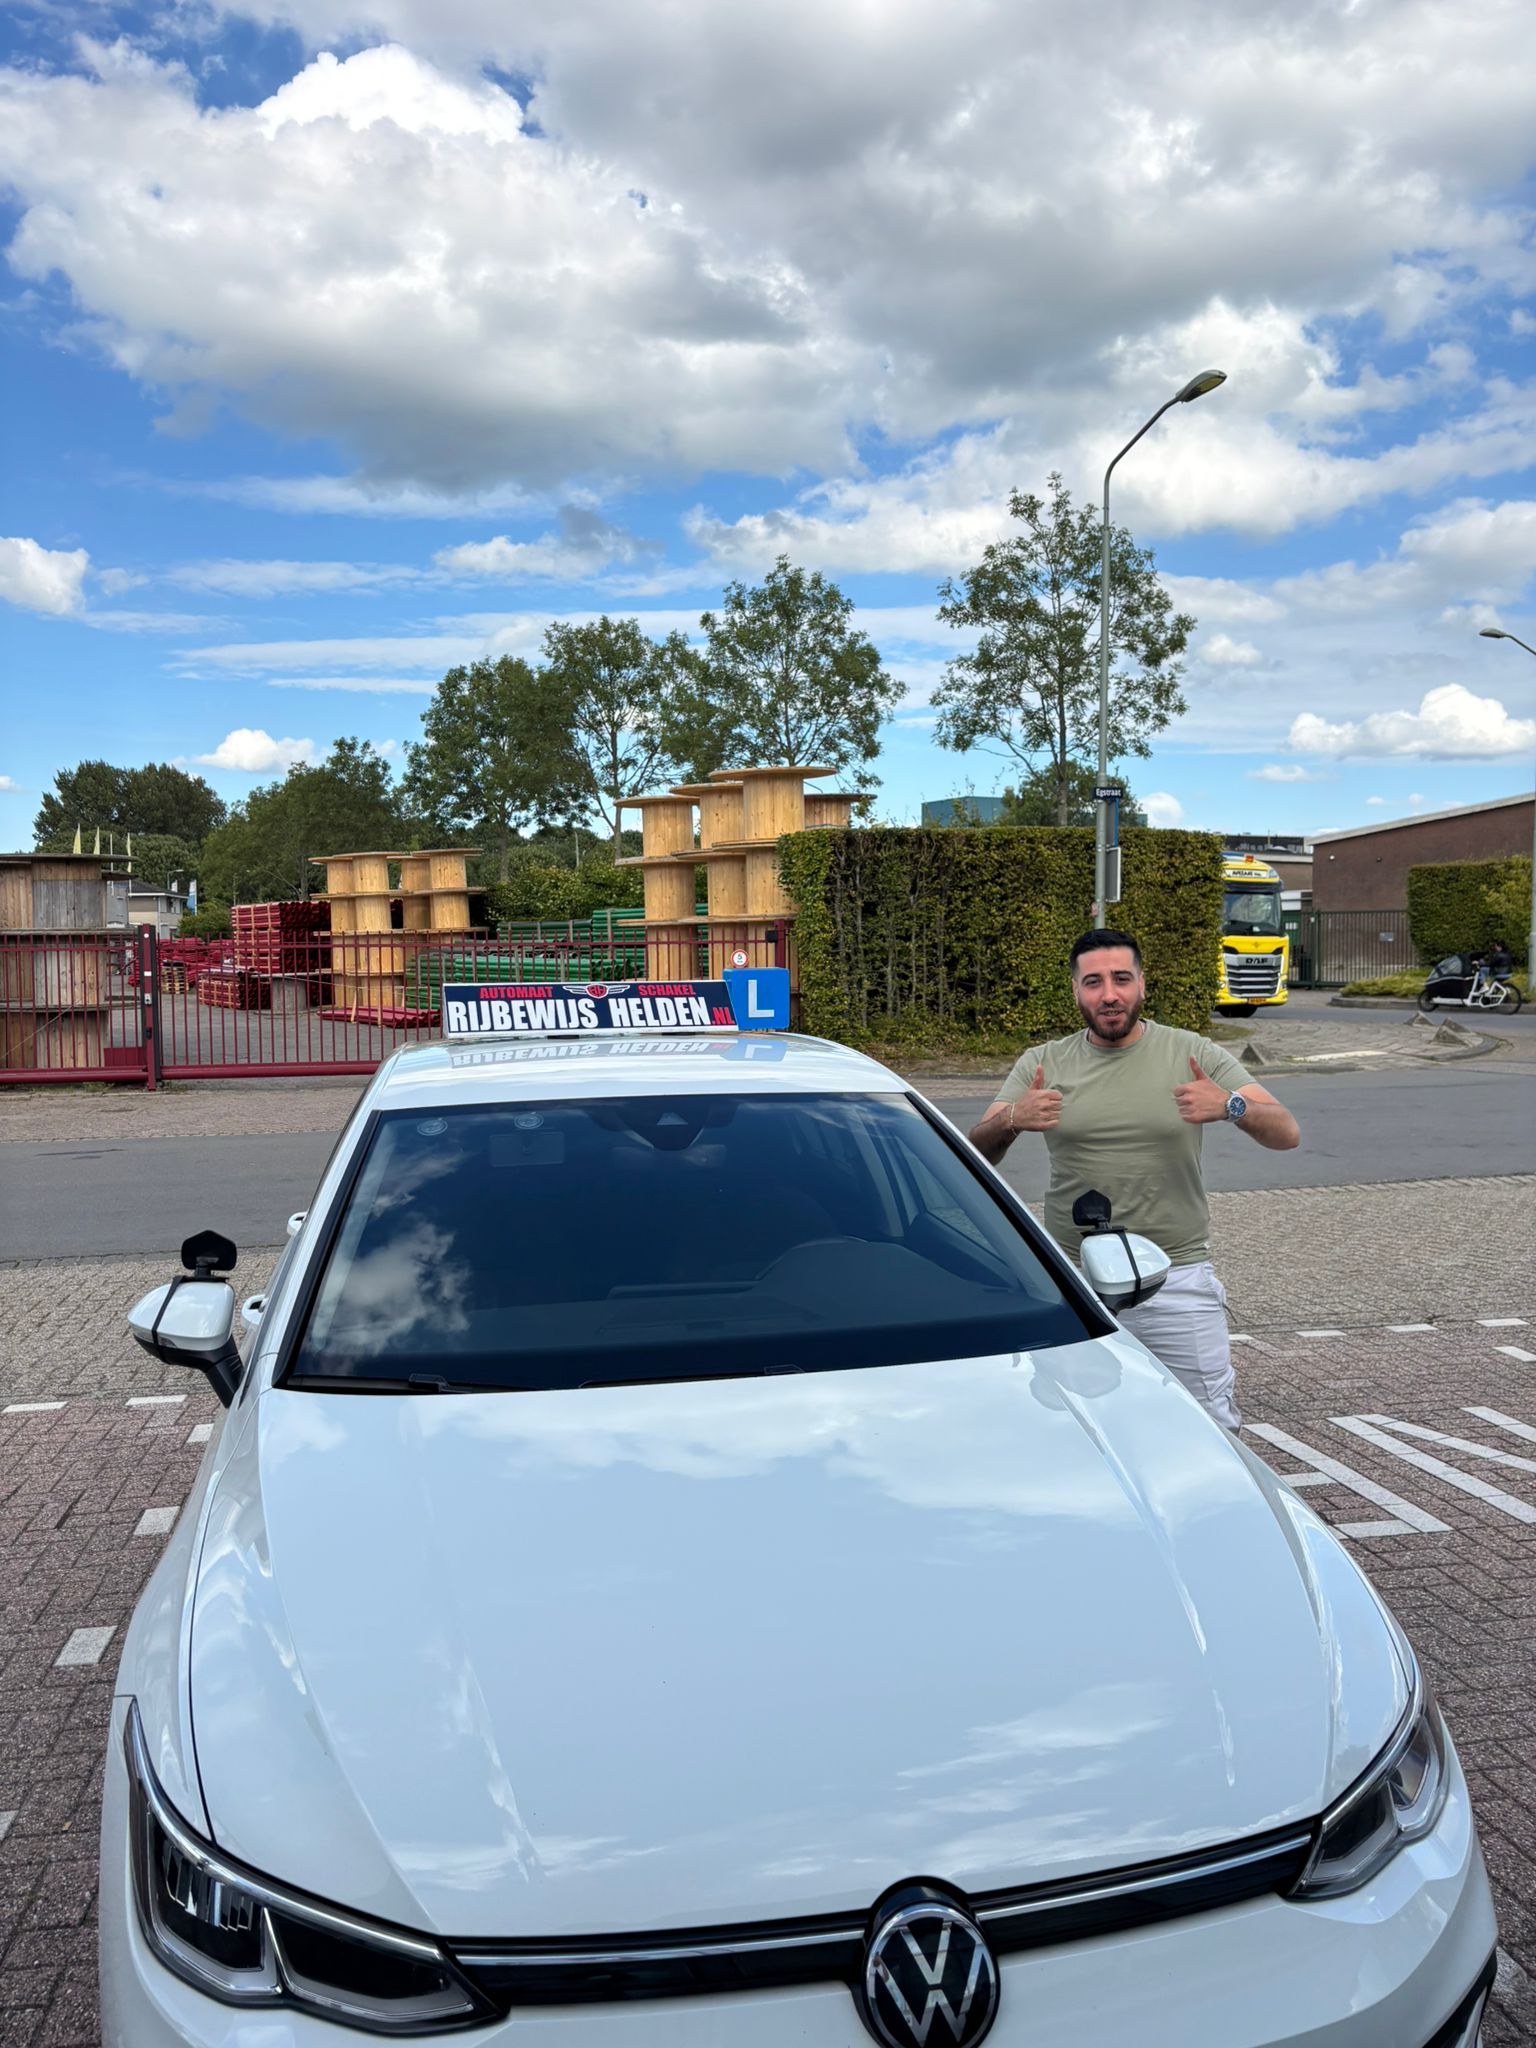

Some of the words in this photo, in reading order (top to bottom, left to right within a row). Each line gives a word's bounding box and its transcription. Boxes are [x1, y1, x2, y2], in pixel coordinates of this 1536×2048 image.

[1246, 957, 1268, 965] DAF
[480, 986, 554, 999] AUTOMAAT
[638, 984, 696, 996] SCHAKEL
[748, 979, 775, 1018] L
[447, 998, 599, 1032] RIJBEWIJS
